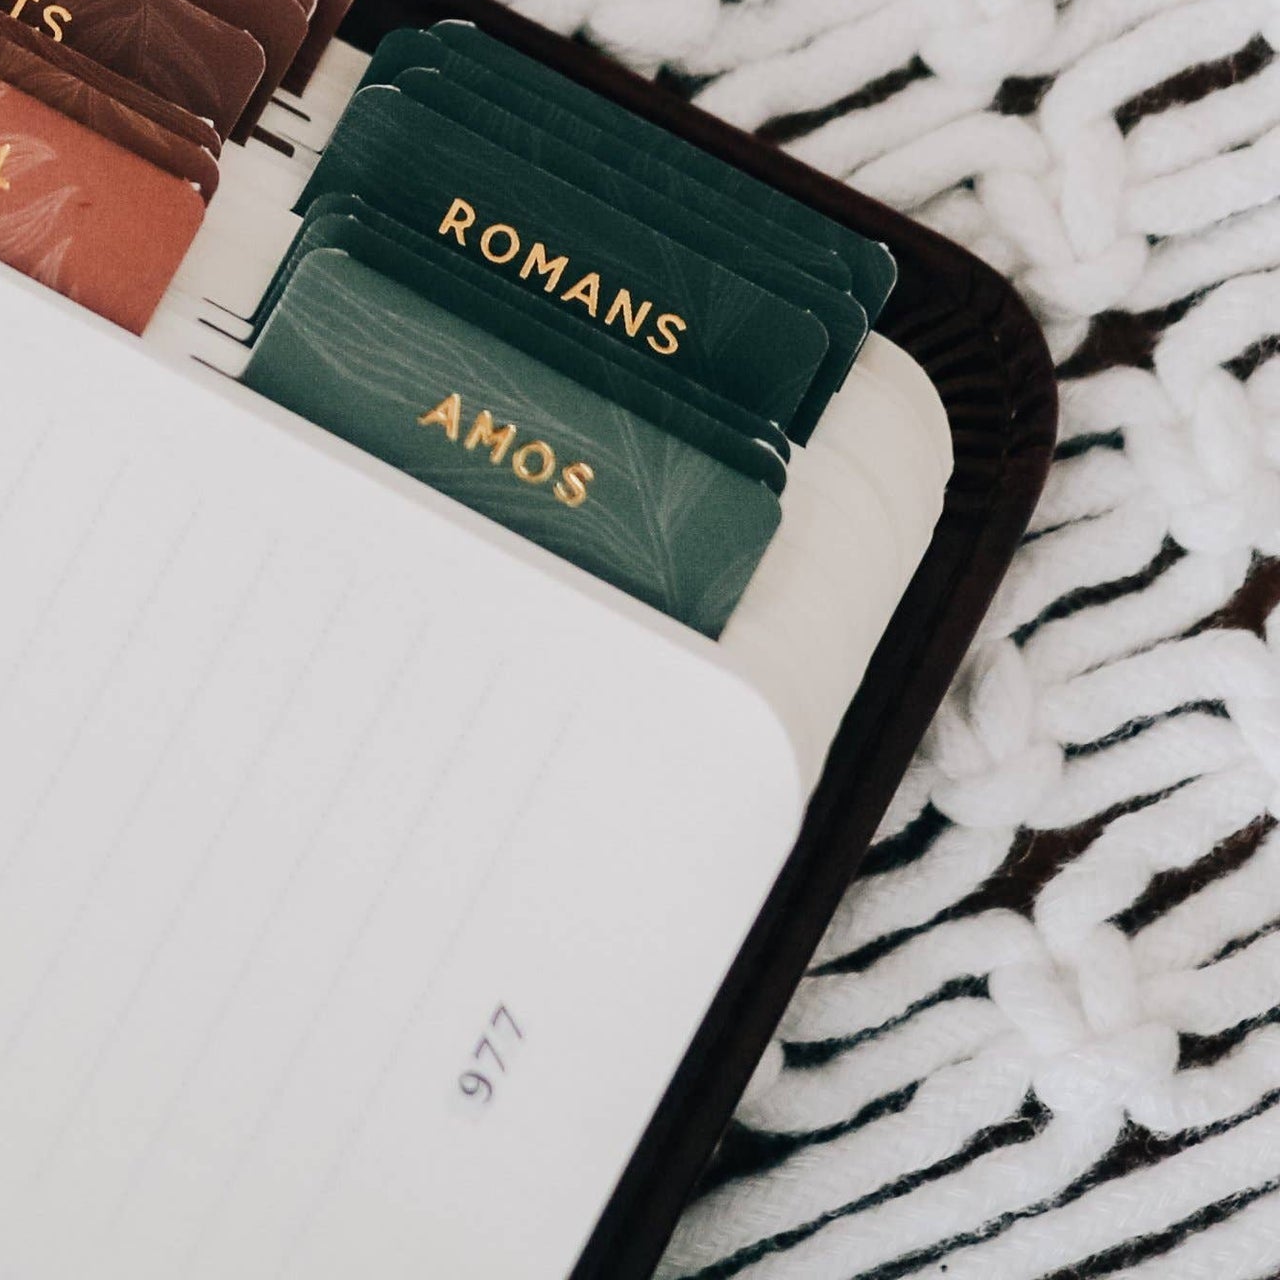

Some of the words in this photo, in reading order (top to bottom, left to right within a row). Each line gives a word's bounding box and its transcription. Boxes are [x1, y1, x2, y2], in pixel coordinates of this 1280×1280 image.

[438, 196, 690, 358] ROMANS
[417, 392, 597, 510] AMOS
[458, 1002, 527, 1104] 977
